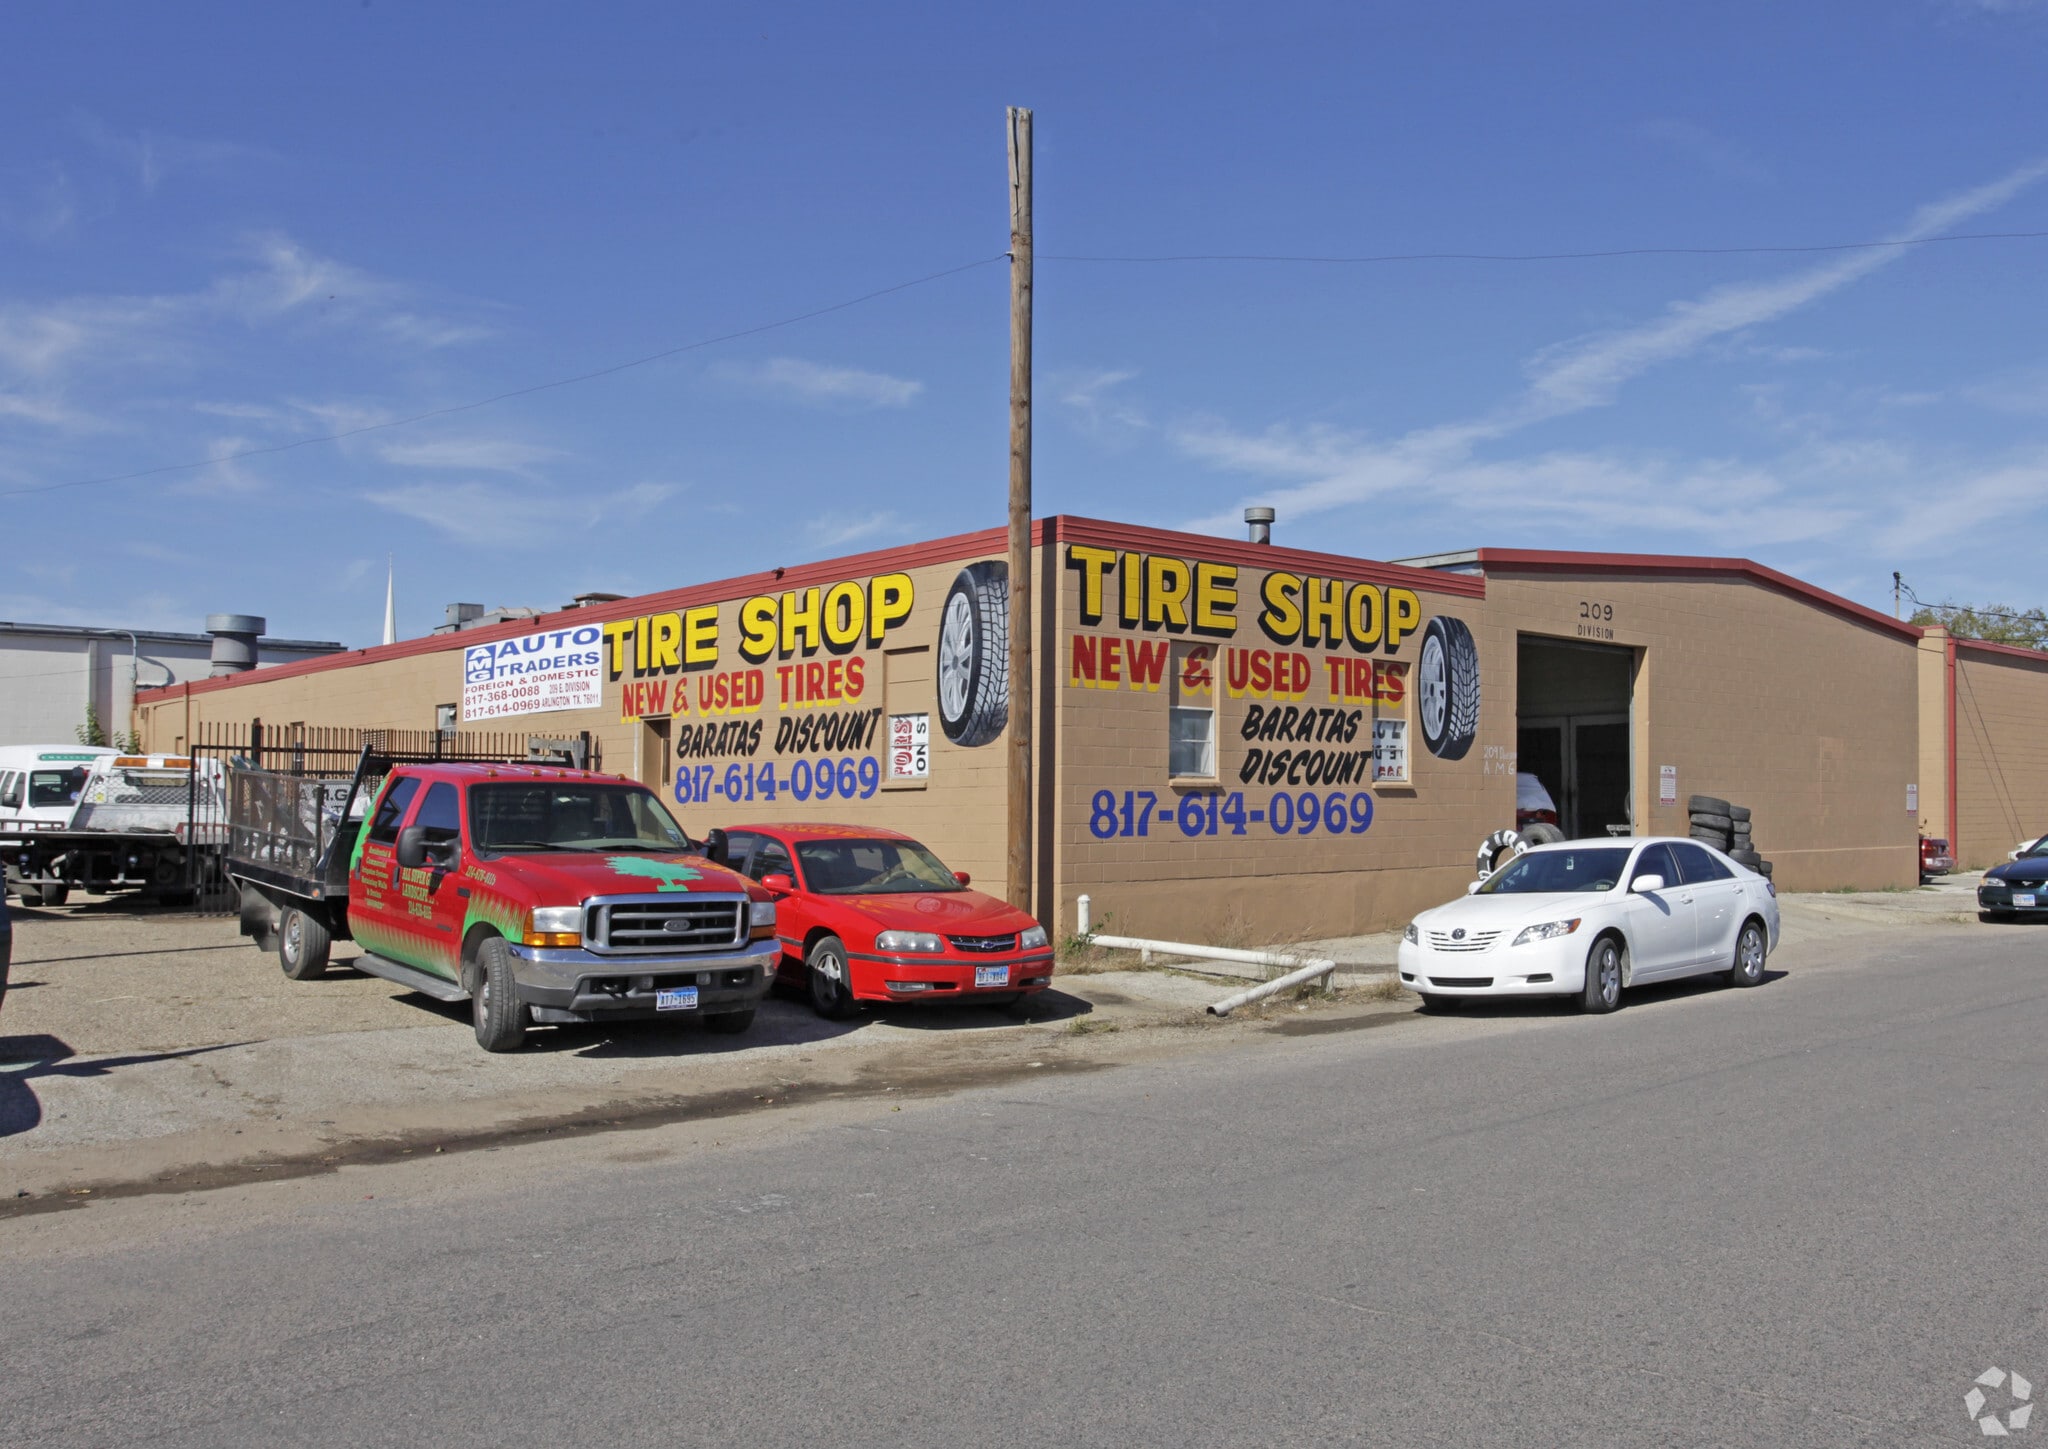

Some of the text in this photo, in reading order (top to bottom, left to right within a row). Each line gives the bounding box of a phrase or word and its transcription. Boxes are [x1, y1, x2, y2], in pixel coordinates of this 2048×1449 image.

[1066, 545, 1421, 655] TIRE SHOP
[1580, 601, 1613, 621] 209
[497, 627, 601, 659] AUTO
[603, 572, 915, 682] TIRE SHOP
[1577, 624, 1614, 640] DIVISION
[465, 668, 599, 695] FOREIGN & DOMESTIC
[496, 651, 600, 678] TRADERS
[1069, 635, 1406, 710] NEW & USED TIRES
[465, 685, 540, 706] 817-368-0088
[542, 696, 571, 707] ARLINGTON
[583, 694, 600, 704] 76011
[549, 683, 559, 694] 209
[565, 680, 591, 692] DIVISION
[621, 656, 865, 719] NEW & USED TIRES
[465, 698, 541, 719] 817-614-0969
[1240, 704, 1363, 744] BARATAS
[676, 707, 883, 759] BARATAS DISCOUNT
[674, 756, 880, 804] 817-614-0969
[1239, 748, 1372, 787] DISCOUNT
[1089, 789, 1374, 839] 817-614-0969
